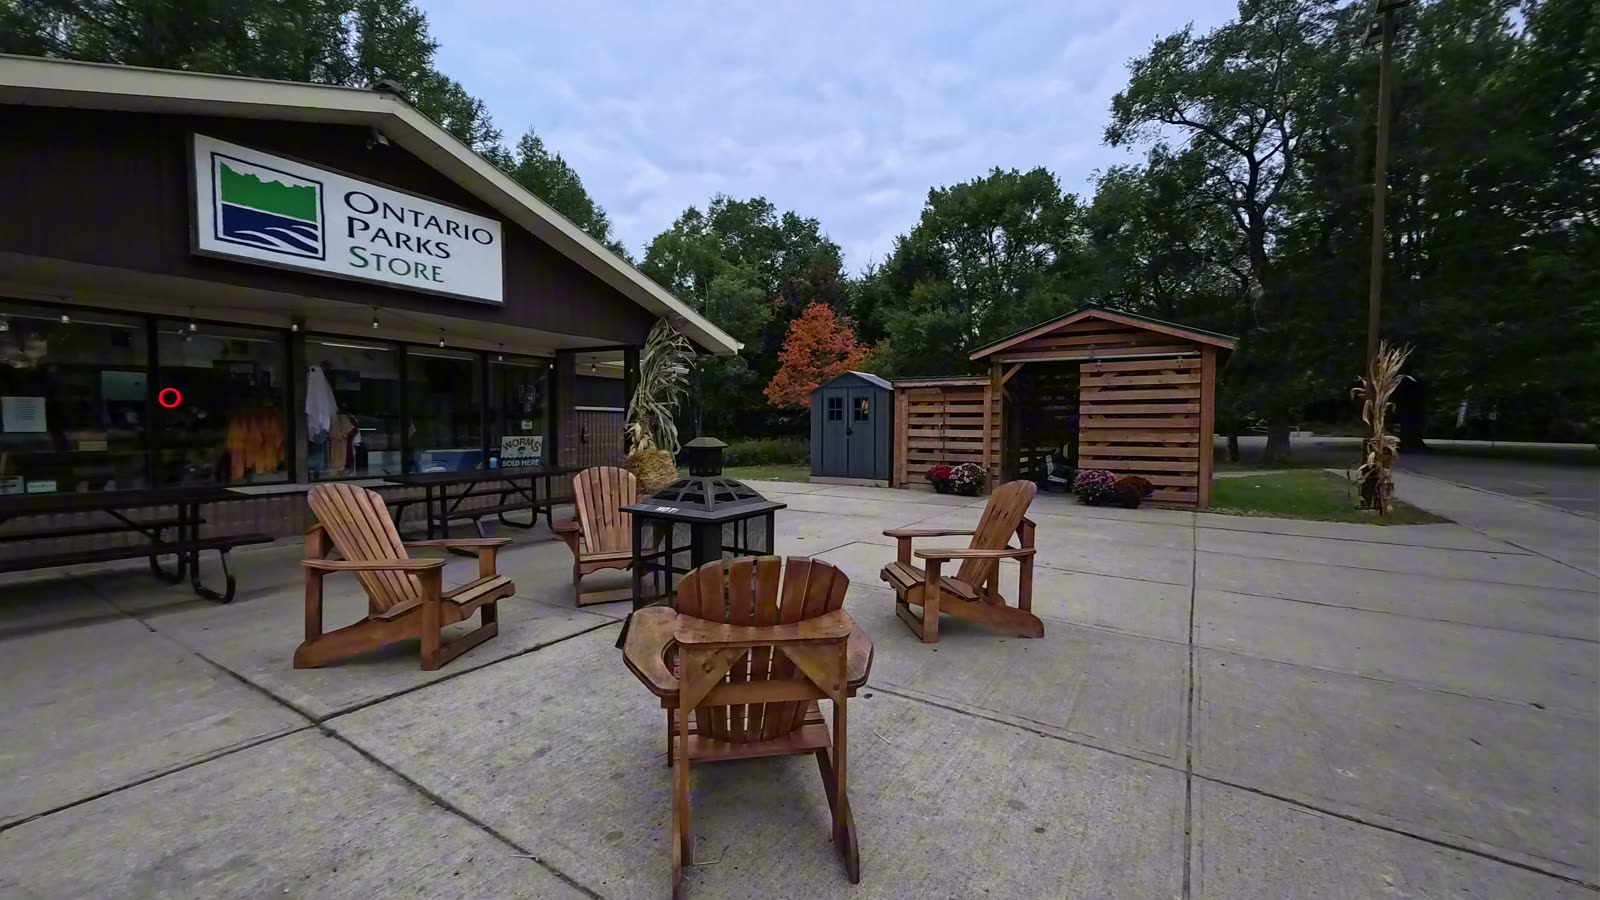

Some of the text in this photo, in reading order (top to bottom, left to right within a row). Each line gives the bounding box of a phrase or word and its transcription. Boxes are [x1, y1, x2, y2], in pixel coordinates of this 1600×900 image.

[344, 191, 493, 245] ONTARIO
[346, 215, 451, 259] PARKS
[349, 245, 445, 283] STORE
[503, 438, 541, 452] WORMS
